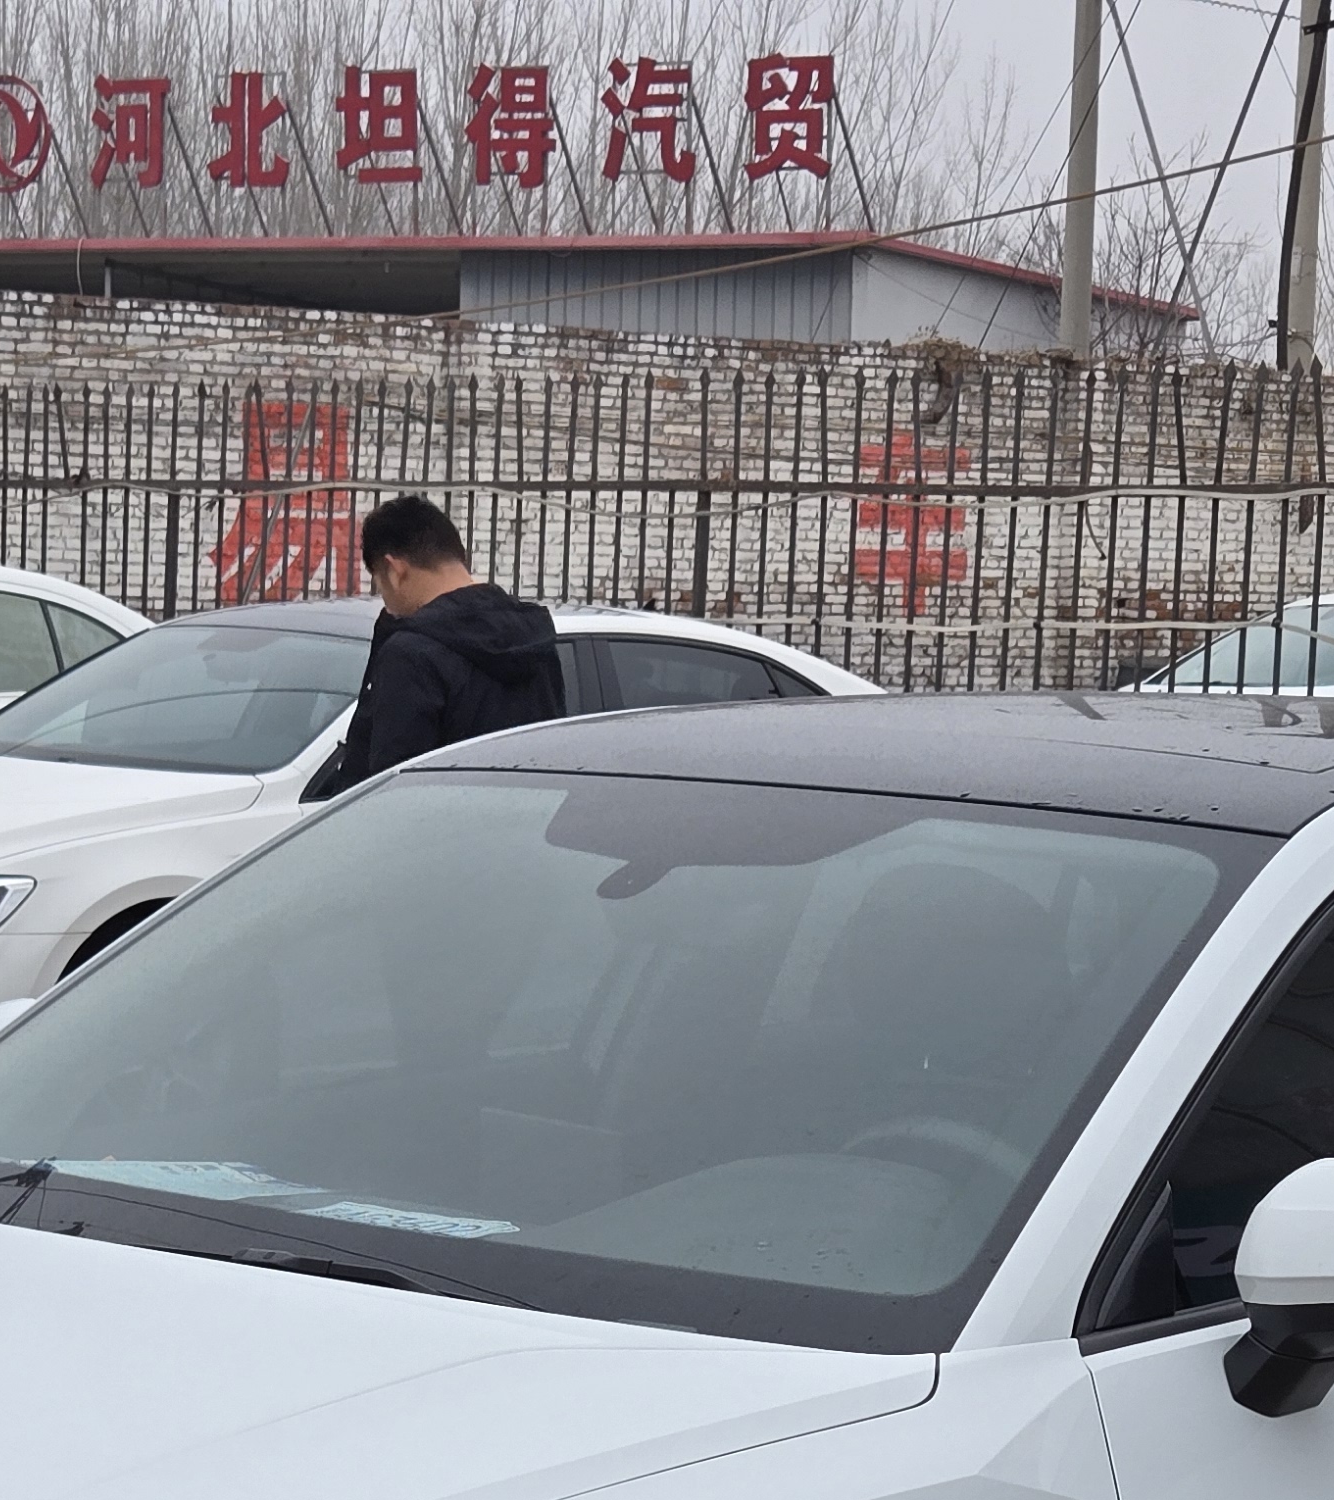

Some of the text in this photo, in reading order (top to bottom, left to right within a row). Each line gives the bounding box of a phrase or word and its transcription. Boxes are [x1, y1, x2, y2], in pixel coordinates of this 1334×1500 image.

[90, 54, 835, 190] 河北坦得汽贸
